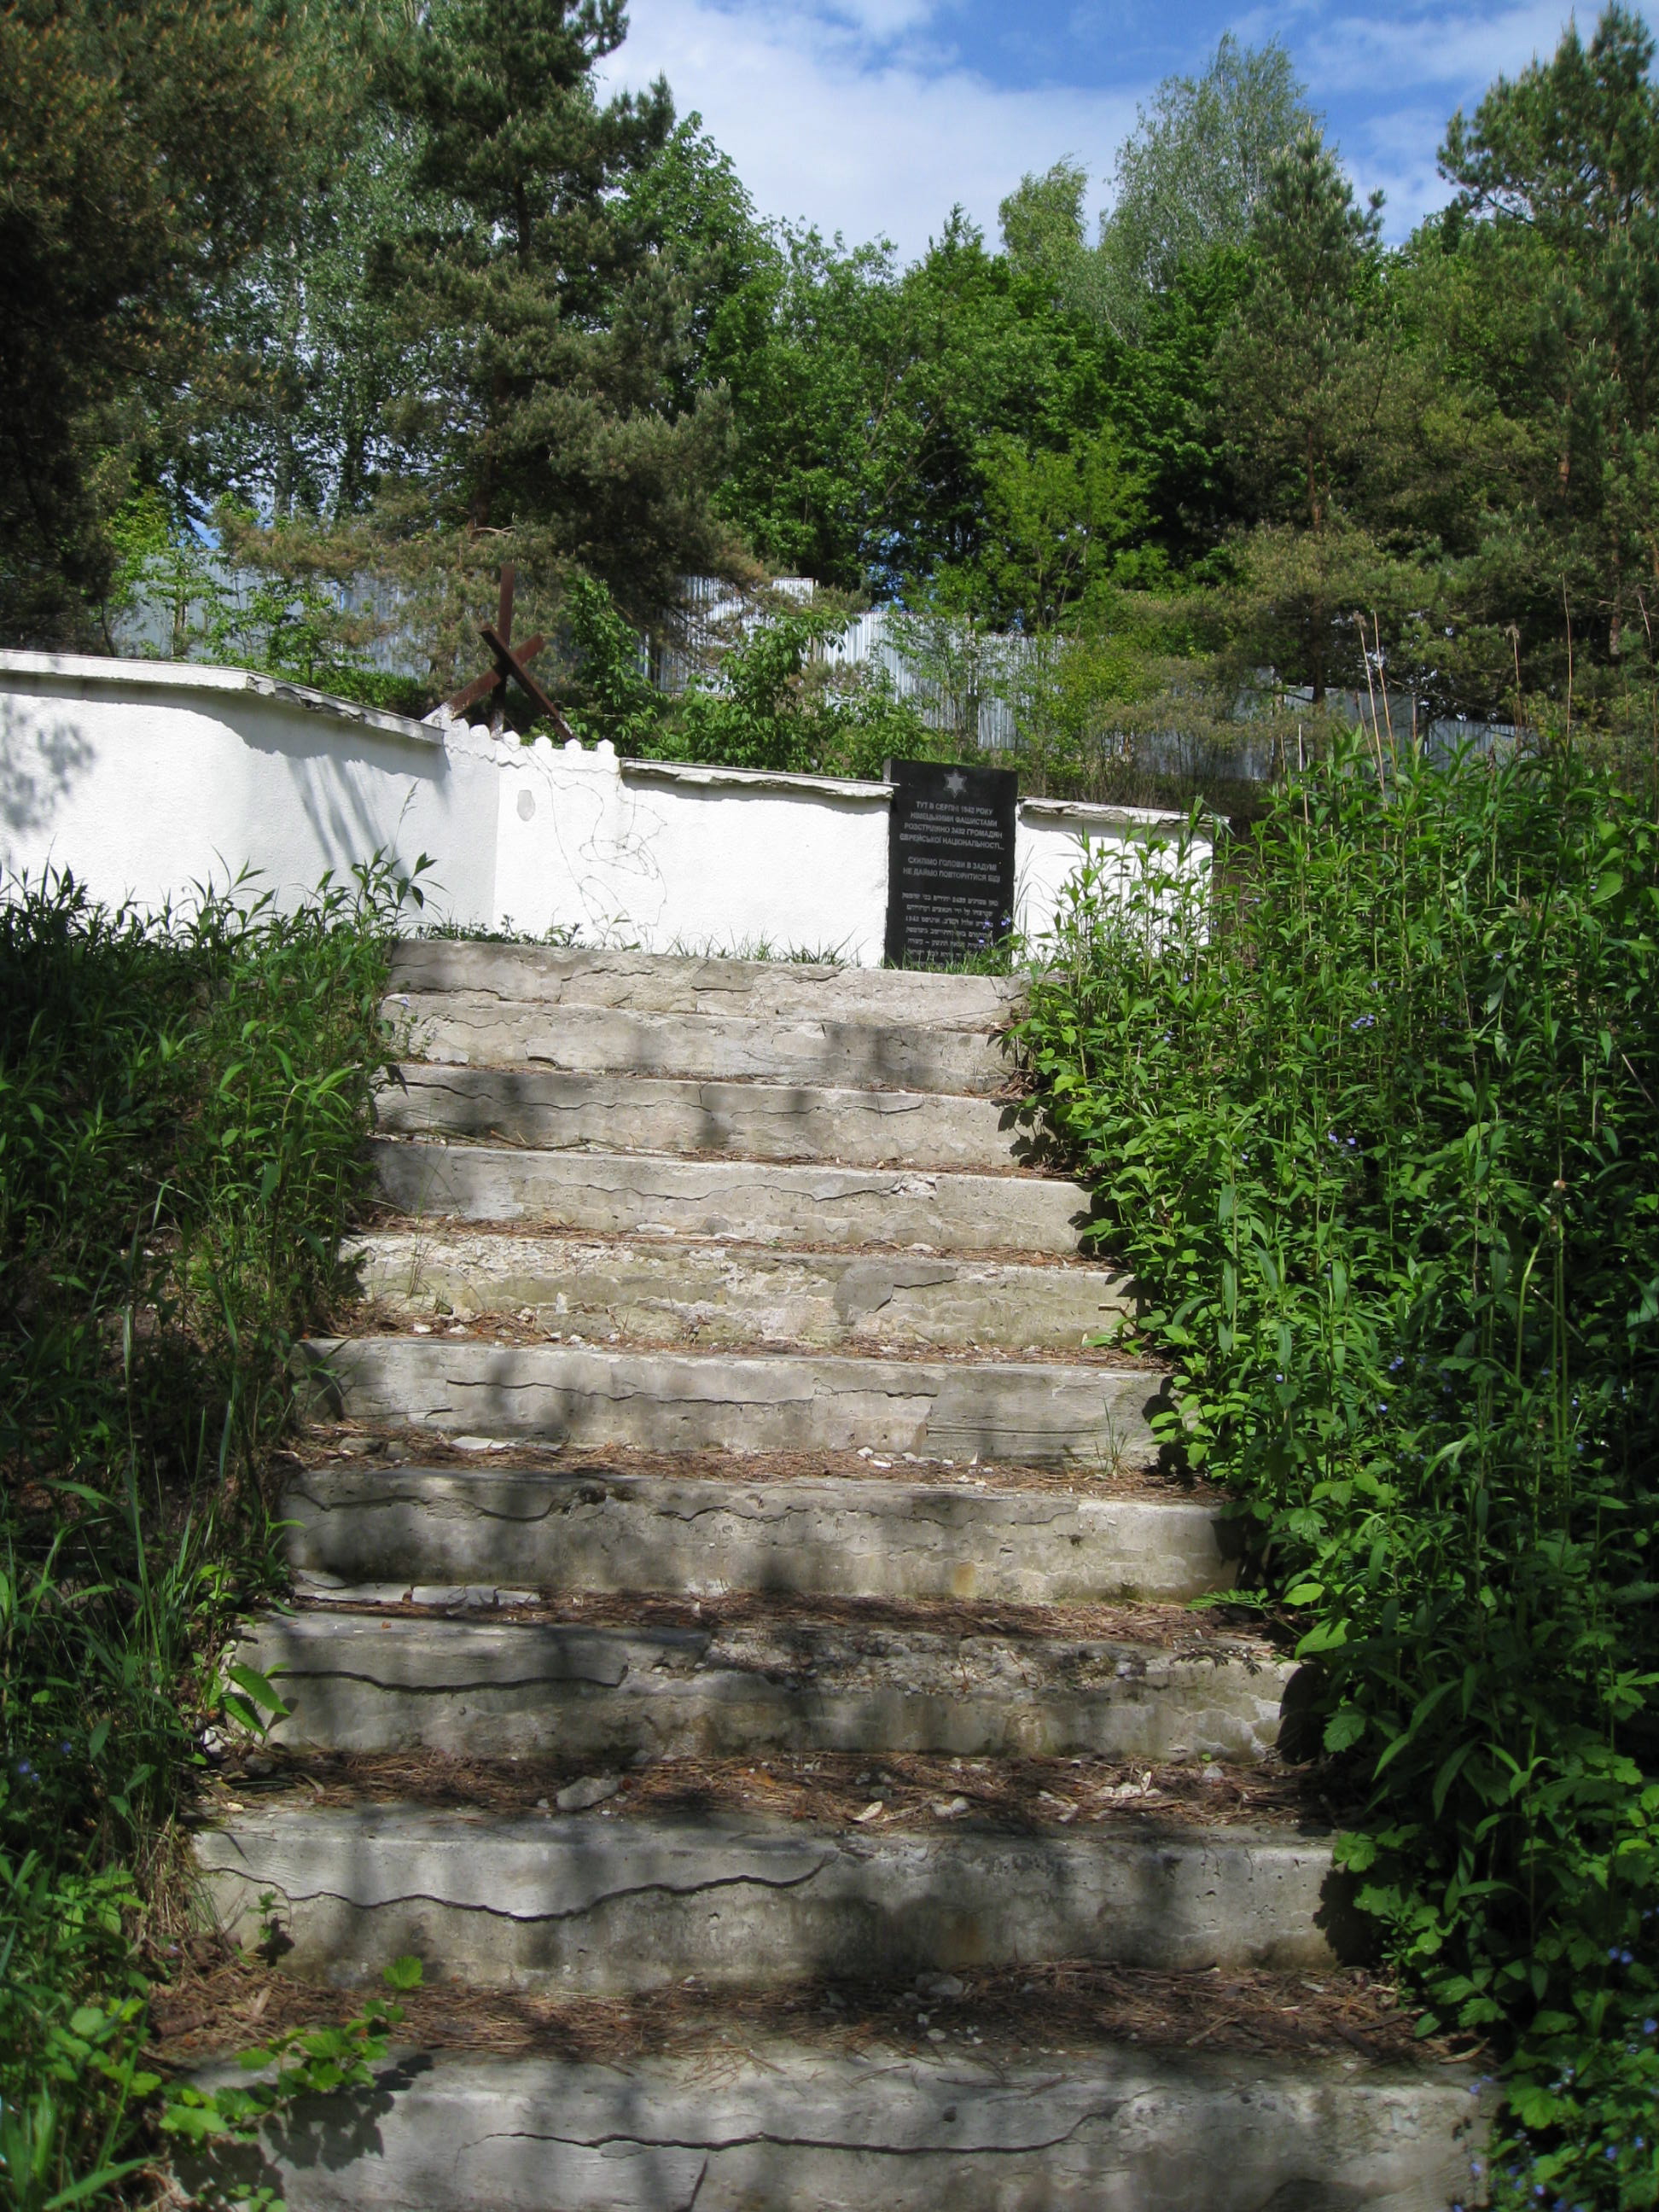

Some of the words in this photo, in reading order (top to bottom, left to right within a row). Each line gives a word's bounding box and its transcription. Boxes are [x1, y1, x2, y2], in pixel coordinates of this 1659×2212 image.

[916, 800, 928, 809] ТУТ
[935, 802, 959, 812] СЕРПНІ
[975, 806, 993, 816] РОКУ
[911, 812, 954, 823] НІМЕЦЬКИМИ
[955, 815, 998, 827] ФАШИСТАМИ
[905, 822, 950, 833] РОЗСТРІЛЯНО
[966, 828, 1003, 839] ГРОМАДЯН
[899, 833, 941, 844] ЄВРЕЙСЬКОЇ
[939, 859, 965, 868] ГОЛОВИ
[939, 870, 987, 882] ПОВТОРИТИСЯ
